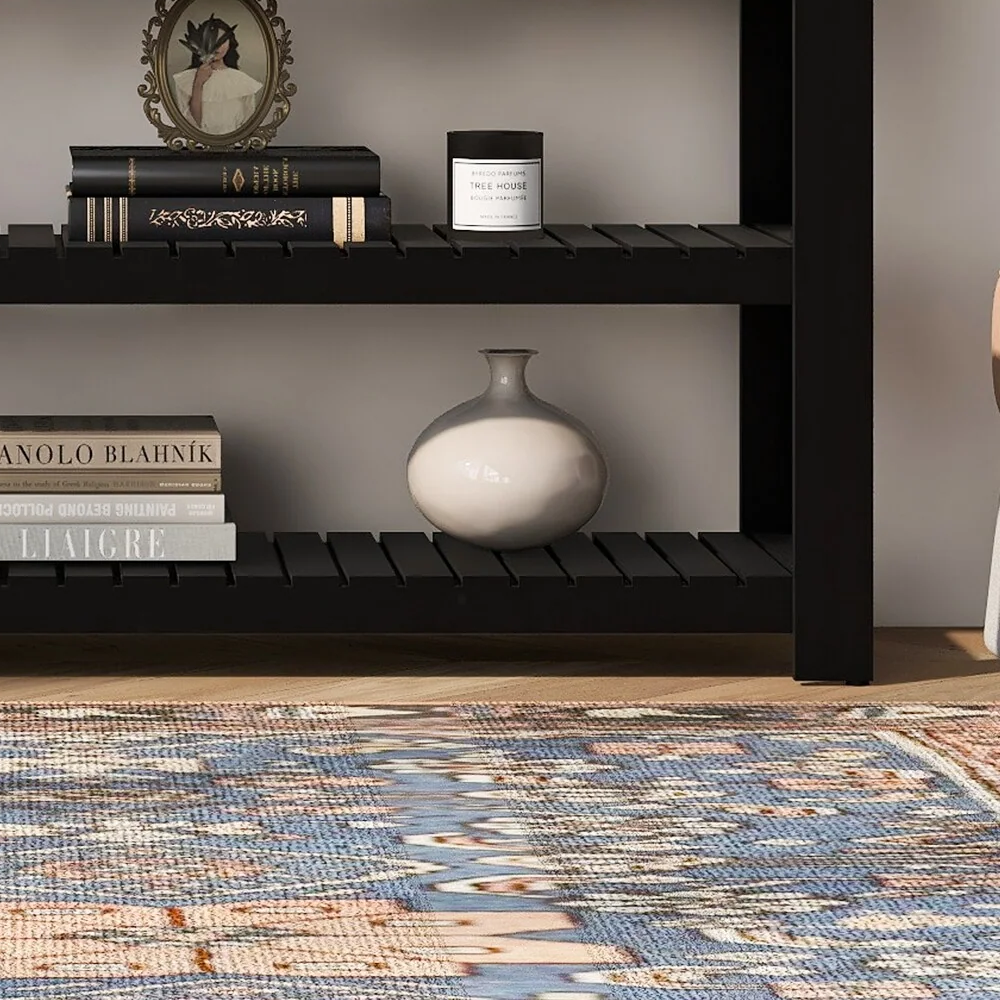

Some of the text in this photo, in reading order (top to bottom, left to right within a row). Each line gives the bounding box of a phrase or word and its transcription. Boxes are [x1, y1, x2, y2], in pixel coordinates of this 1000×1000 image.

[470, 181, 528, 190] TREE HOUSE
[104, 440, 213, 463] BLAHNÍK
[58, 502, 111, 517] BEYOND
[115, 502, 177, 517] PAINTING
[21, 528, 166, 560] LIAIGRE
